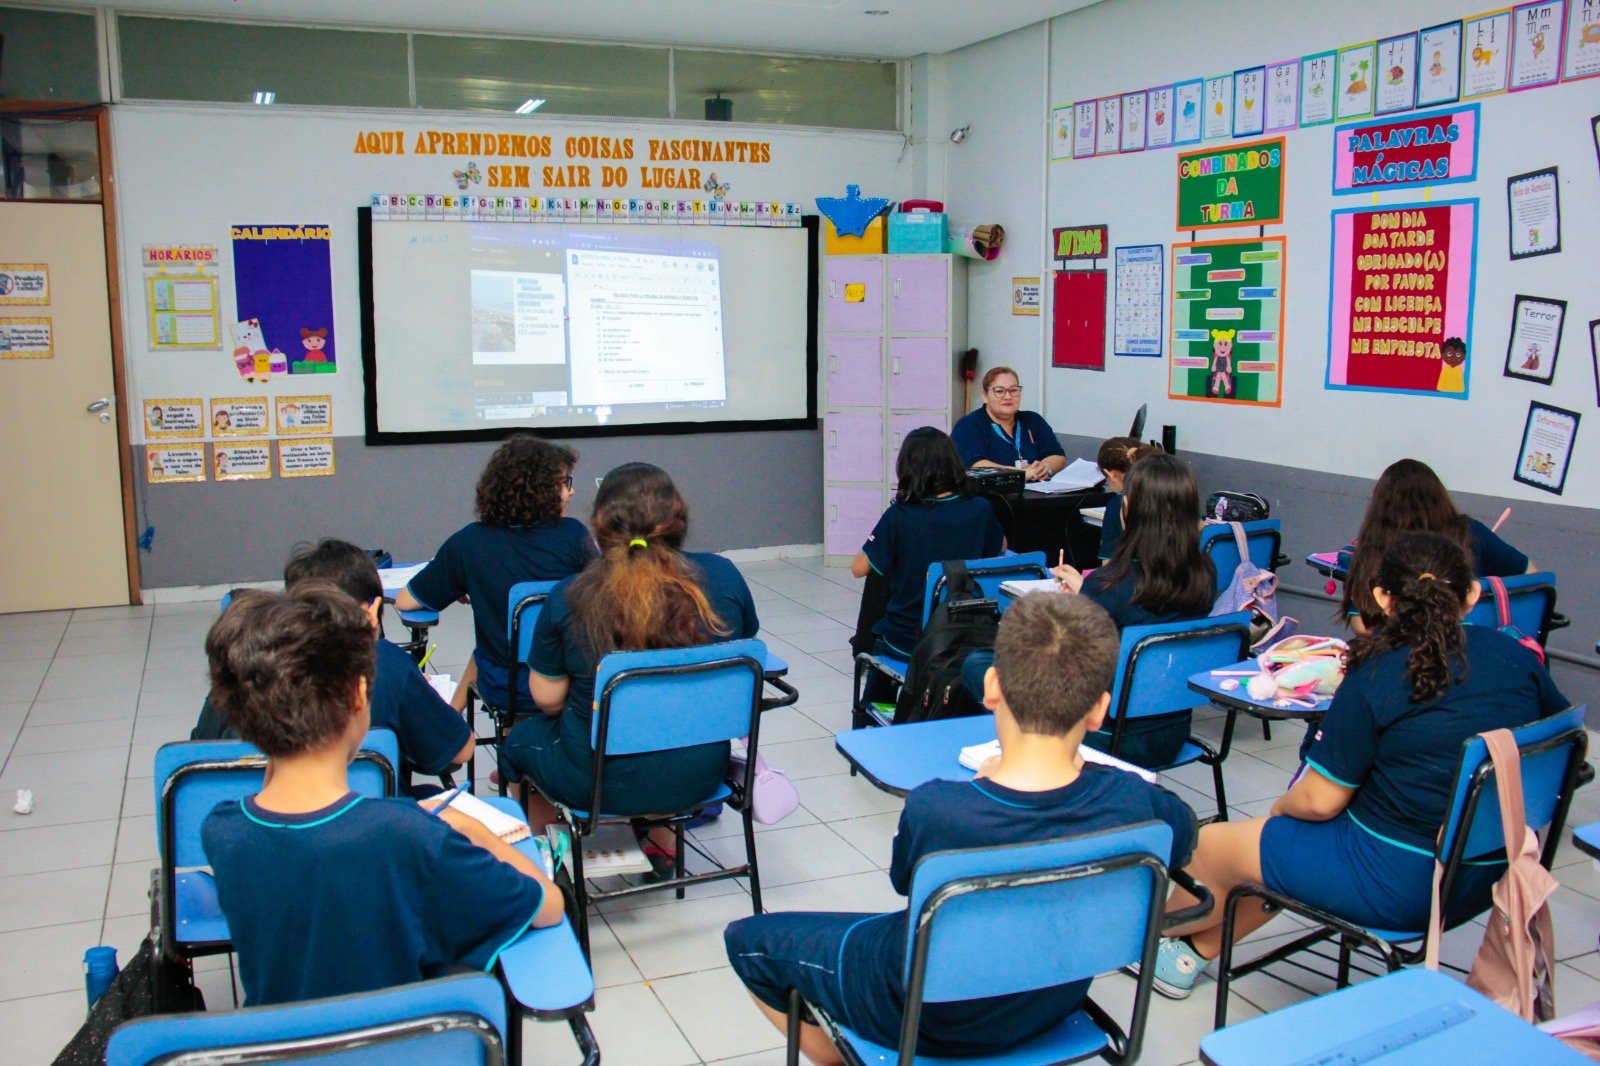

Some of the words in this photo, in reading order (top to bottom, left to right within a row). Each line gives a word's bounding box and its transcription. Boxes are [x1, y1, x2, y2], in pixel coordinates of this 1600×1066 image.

[354, 132, 405, 155] AQUI
[414, 132, 552, 158] APRENDEMOS
[566, 138, 634, 160] COISAS
[648, 139, 770, 162] FASCINANTES
[1348, 124, 1459, 152] PALAVRAS
[1180, 149, 1280, 178] COMBINADOS
[1352, 152, 1448, 184] MÁGICAS
[488, 166, 529, 188] SEM
[542, 167, 590, 188] SAIR
[602, 167, 628, 188] DO
[641, 168, 701, 190] LUGAR
[1216, 177, 1238, 197] DA
[1200, 200, 1255, 222] TURMA
[1371, 212, 1400, 230] BOM
[1402, 211, 1427, 228] DIA
[230, 224, 331, 240] CALENDÁRIO
[1363, 233, 1388, 250] BOA
[1390, 230, 1435, 248] TARDE
[1357, 250, 1445, 271] OBRIGADO(A)
[1365, 275, 1389, 291] POR
[1393, 273, 1434, 291] FAVOR
[1355, 296, 1381, 312] COM
[1385, 296, 1442, 315] LICENÇA
[1524, 307, 1557, 321] Terror
[1353, 317, 1371, 332] ME
[1374, 317, 1441, 334] DESCULPE
[1351, 338, 1369, 354] ME
[1372, 339, 1441, 359] EMPRESTA
